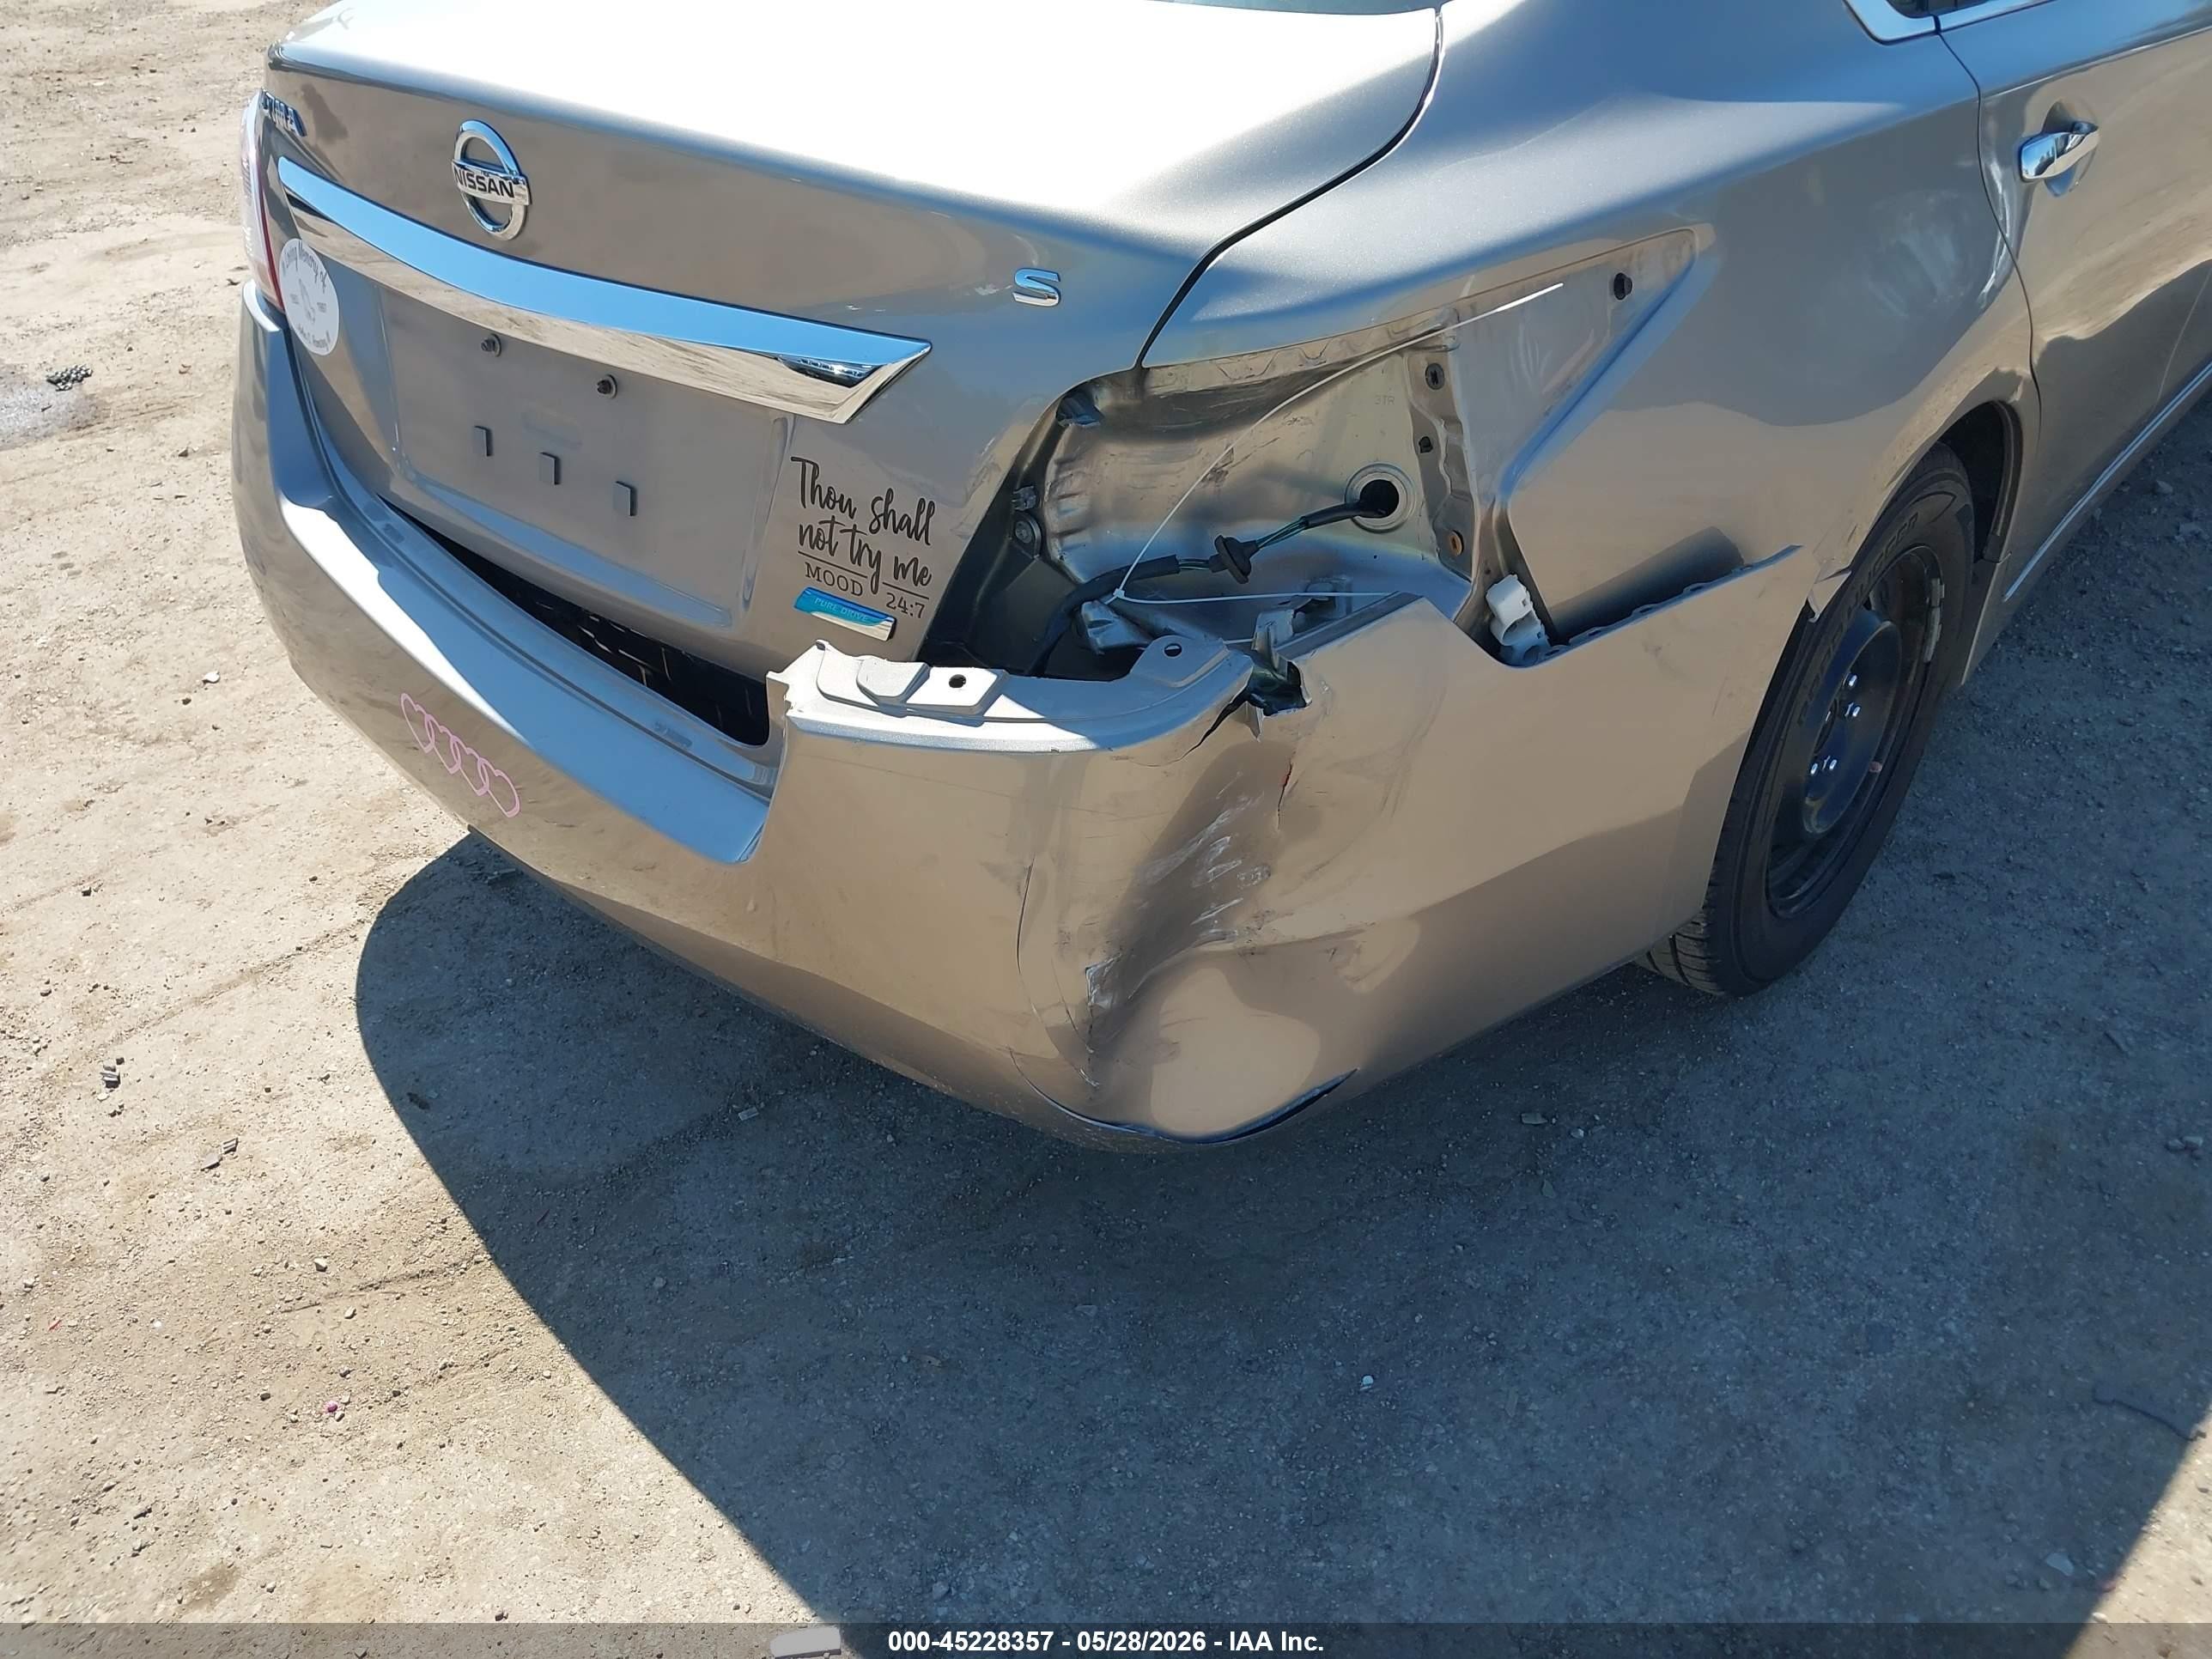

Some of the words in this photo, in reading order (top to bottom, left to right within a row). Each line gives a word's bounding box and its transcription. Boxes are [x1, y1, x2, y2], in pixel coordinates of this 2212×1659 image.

[453, 165, 515, 198] NISSAN
[1012, 267, 1061, 307] S
[790, 456, 857, 520] Thou
[798, 515, 846, 556] not
[840, 524, 882, 594] try
[893, 556, 933, 586] me
[805, 562, 863, 597] MOOD
[885, 592, 925, 619] 24:7
[814, 597, 838, 612] PURE
[840, 606, 868, 622] DRIVE
